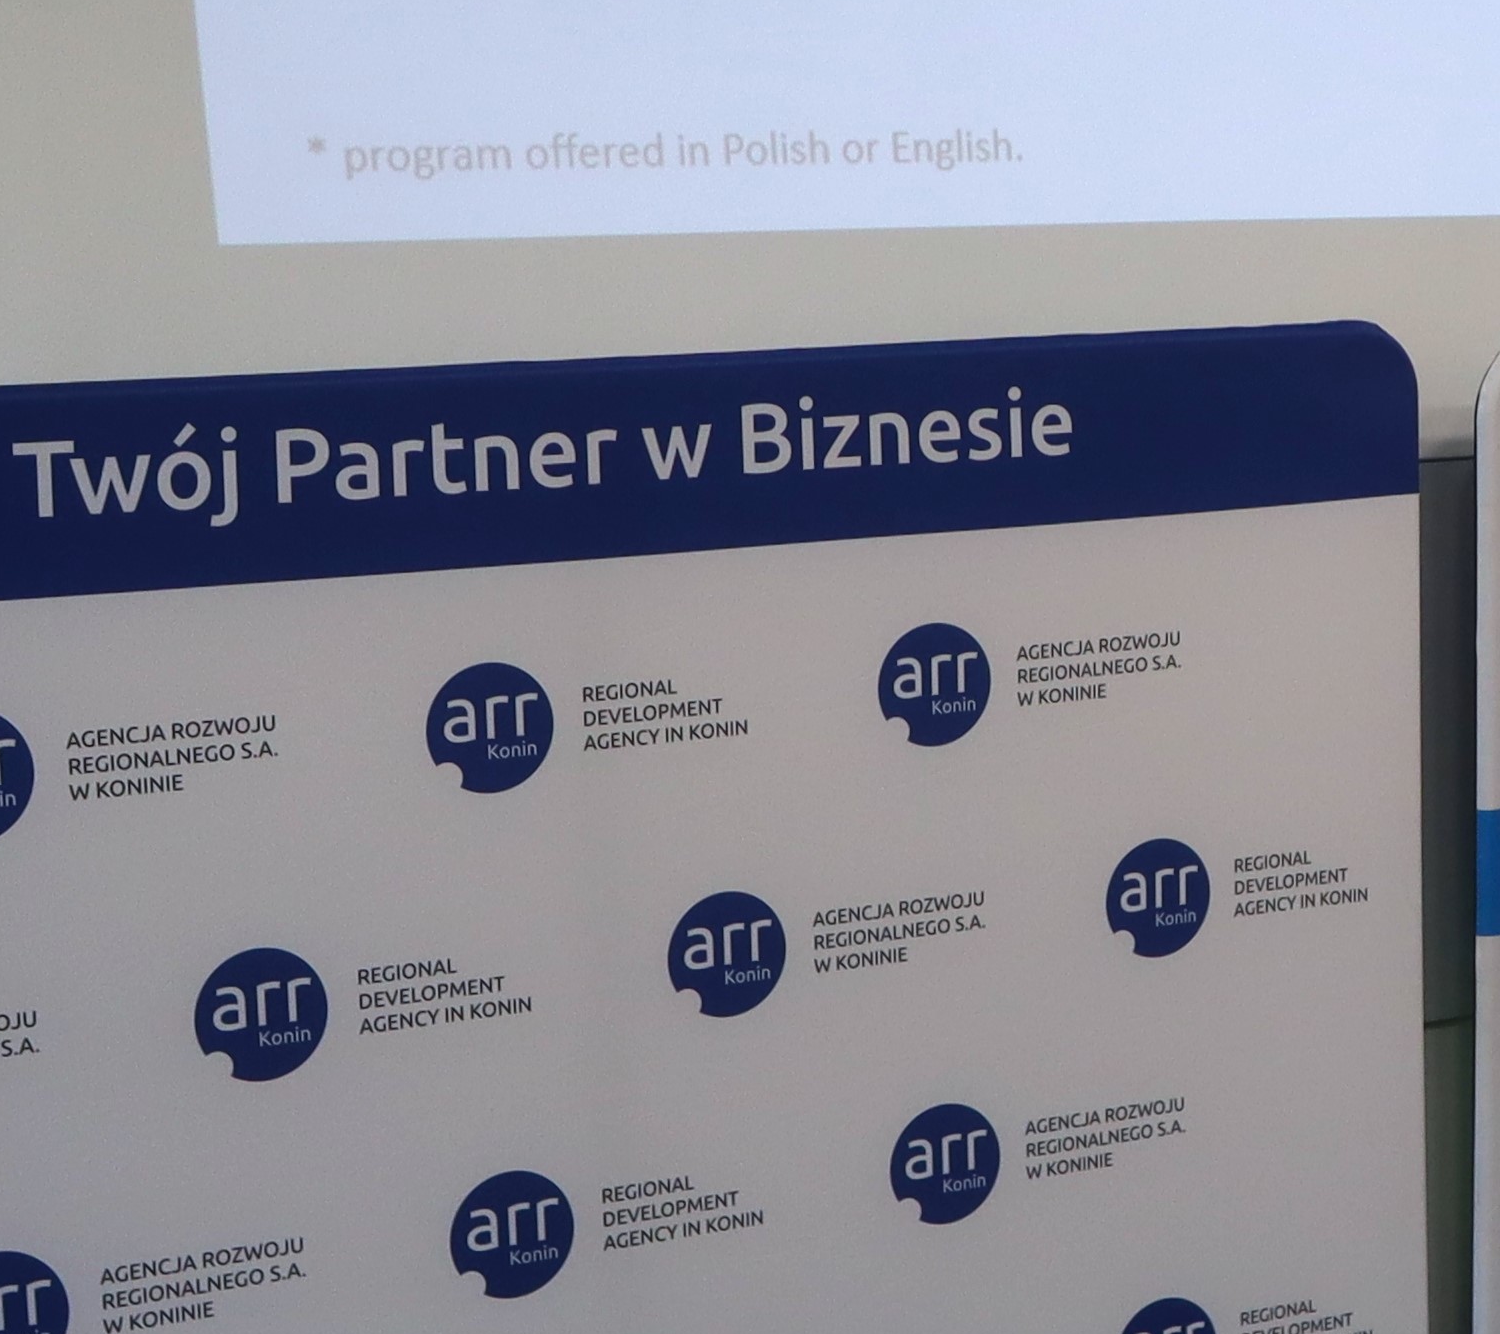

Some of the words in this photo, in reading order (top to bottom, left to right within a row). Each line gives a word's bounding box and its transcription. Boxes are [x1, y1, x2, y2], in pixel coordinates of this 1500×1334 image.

[342, 136, 512, 180] program
[523, 129, 667, 174] offered
[675, 130, 713, 169] in
[721, 127, 831, 169] Polish
[840, 138, 880, 168] or
[889, 126, 1026, 176] English.
[12, 419, 241, 525] Twój
[276, 417, 614, 509] Partner
[643, 419, 713, 480] w
[737, 385, 1077, 475] Biznesie
[582, 679, 678, 702] REGIONAL
[893, 651, 978, 699] arr
[65, 724, 165, 750] AGENCJA
[171, 715, 276, 741] ROZWOJU
[443, 692, 538, 744] arr
[583, 698, 723, 727] DEVELOPMENT
[583, 729, 660, 751] AGENCY
[665, 727, 684, 743] IN
[689, 719, 749, 739] KONIN
[68, 743, 235, 775] REGIONALNEGO
[240, 741, 279, 760] S.A.
[488, 742, 538, 760] Konin
[69, 783, 90, 802] W
[96, 774, 184, 800] KONINIE
[1120, 865, 1198, 913] arr
[683, 919, 772, 970] arr
[212, 977, 312, 1032] arr
[1, 1039, 41, 1058] S.A.
[904, 1129, 988, 1180] arr
[466, 1197, 559, 1252] arr
